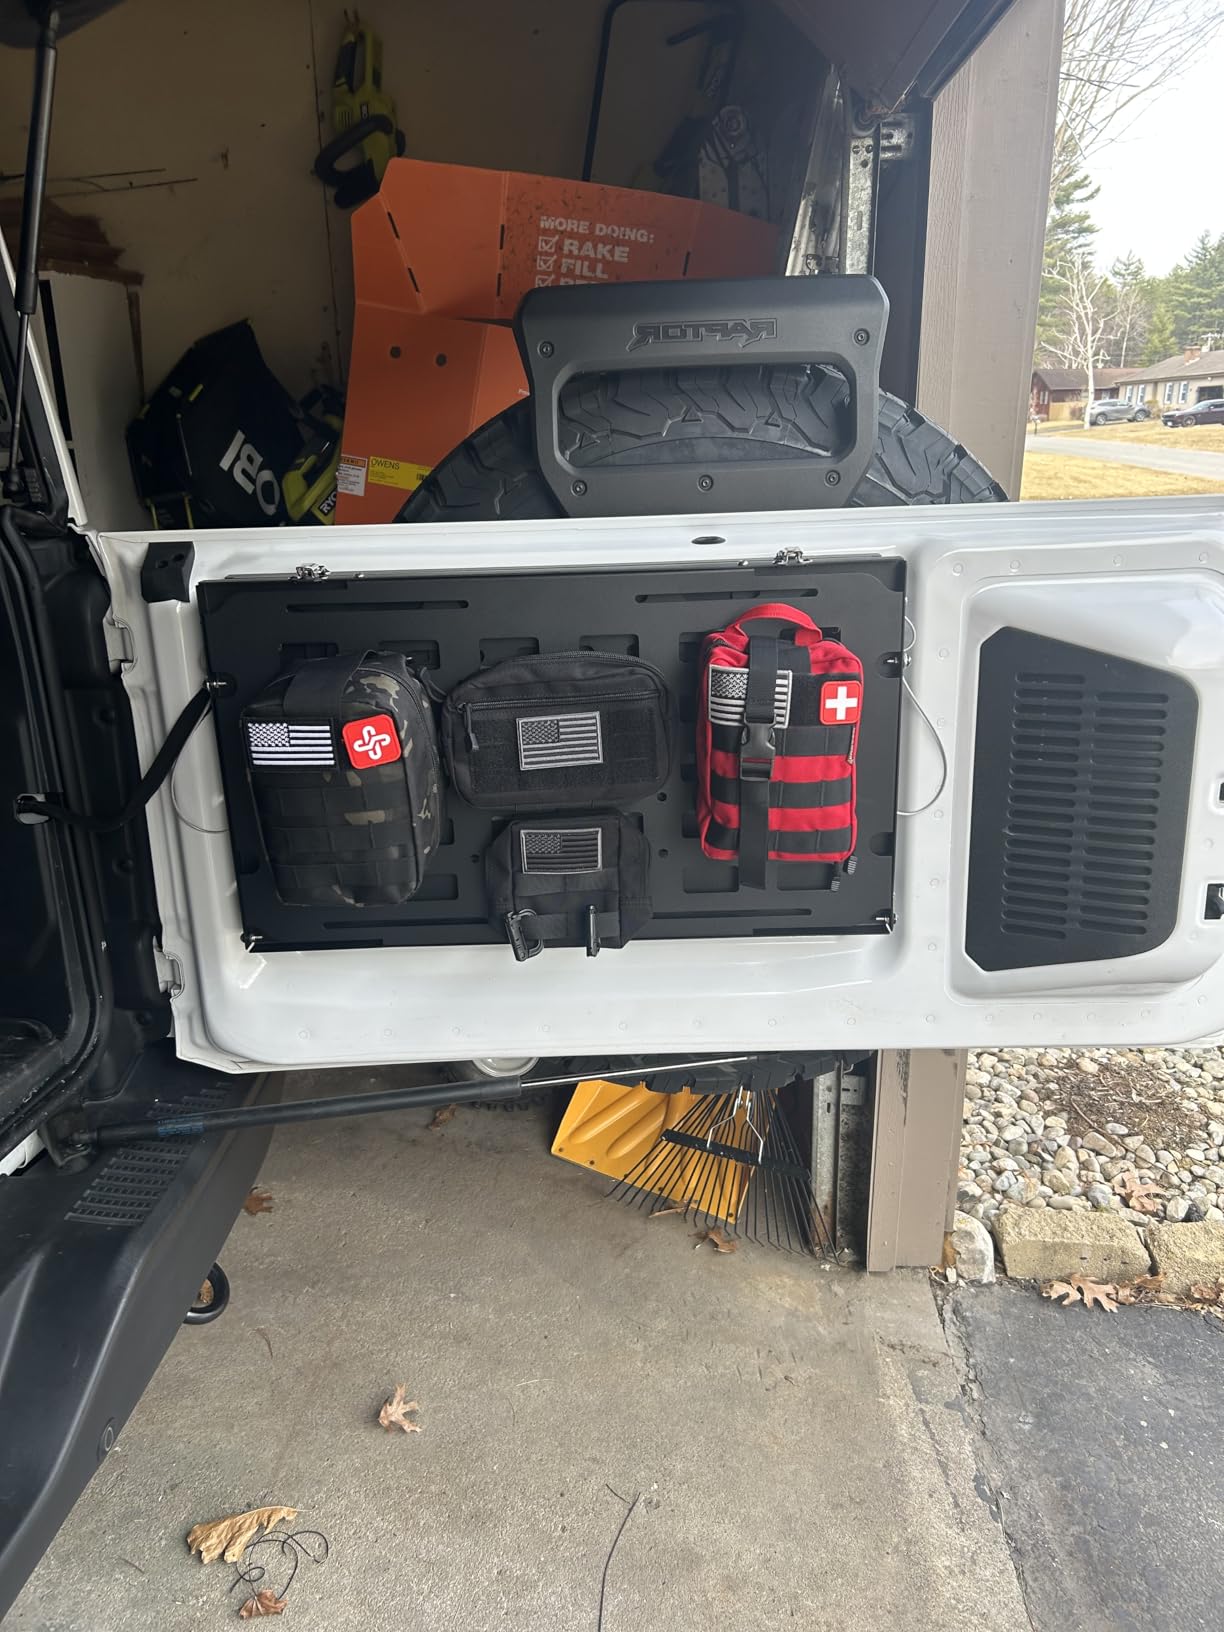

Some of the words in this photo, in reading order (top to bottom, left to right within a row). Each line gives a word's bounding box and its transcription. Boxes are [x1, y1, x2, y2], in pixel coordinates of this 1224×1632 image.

[540, 216, 591, 234] MORE
[595, 223, 654, 243] DOING:
[562, 238, 630, 263] RAKE
[560, 258, 609, 279] FILL
[219, 429, 281, 516] OBI
[371, 459, 400, 471] OWENS
